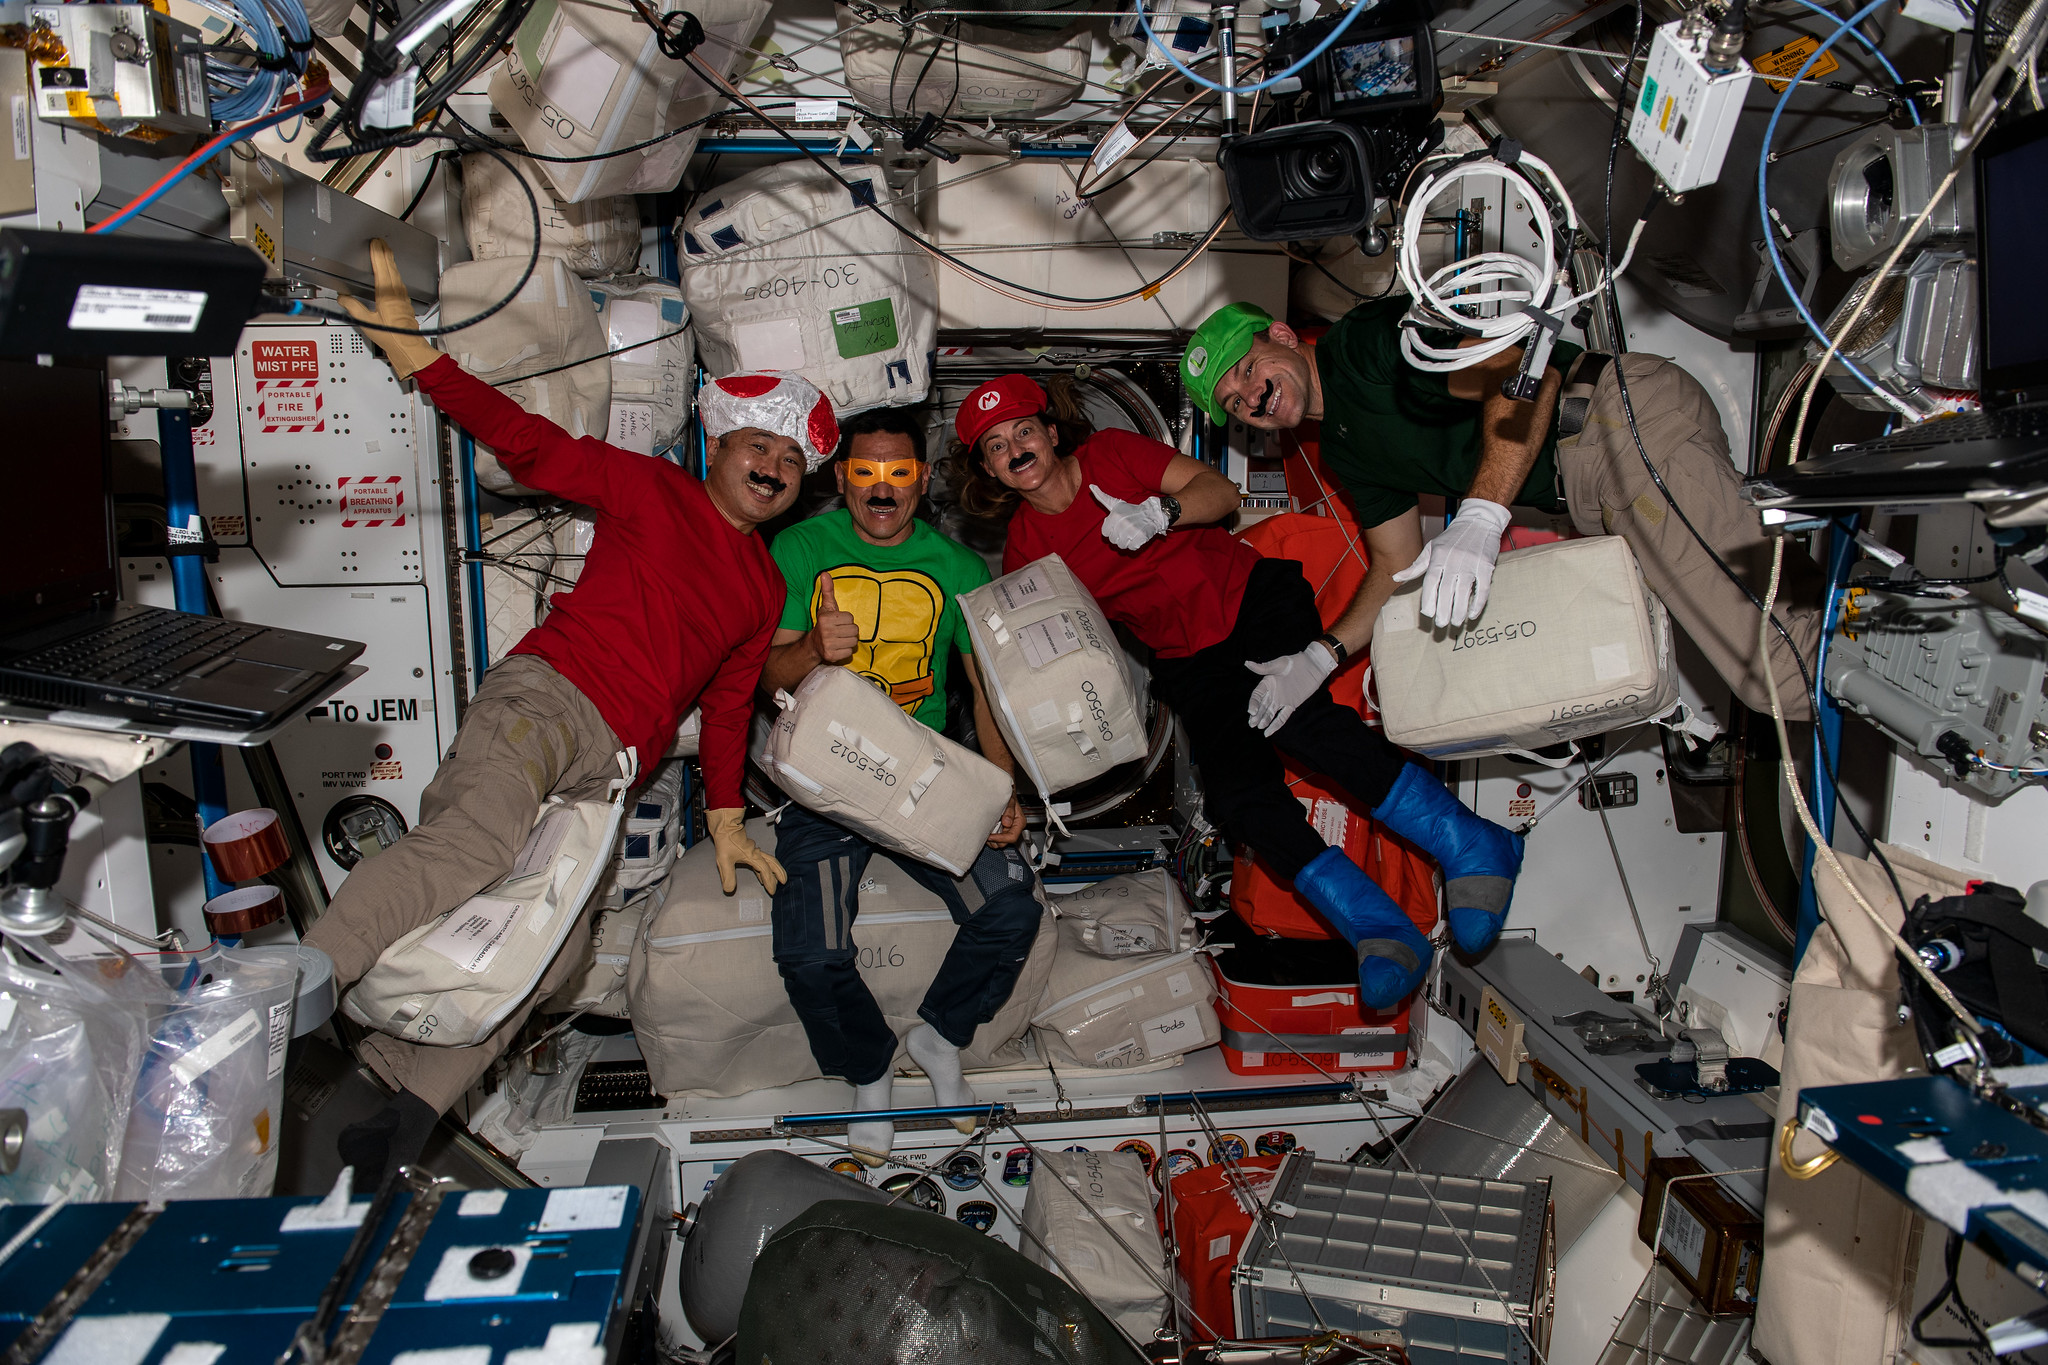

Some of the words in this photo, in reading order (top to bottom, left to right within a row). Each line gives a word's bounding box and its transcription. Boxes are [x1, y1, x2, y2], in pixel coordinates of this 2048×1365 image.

[1772, 48, 1806, 66] WARNING
[744, 263, 859, 301] 3.0-4085
[261, 346, 310, 357] WATER
[256, 361, 288, 372] MIST
[292, 361, 317, 372] PFE
[661, 359, 677, 408] 4049
[277, 403, 304, 412] FIRE
[982, 392, 998, 409] M
[350, 498, 394, 506] BREATHING
[1453, 620, 1537, 652] 0.5-5397
[328, 700, 359, 722] To
[366, 698, 418, 722] JEM
[1081, 680, 1114, 742] 0.5-5500
[830, 740, 897, 786] 0.5-5012
[510, 904, 520, 919] CREW
[493, 919, 511, 941] SUITCASE
[855, 944, 904, 968] 016
[1272, 1134, 1280, 1142] 2
